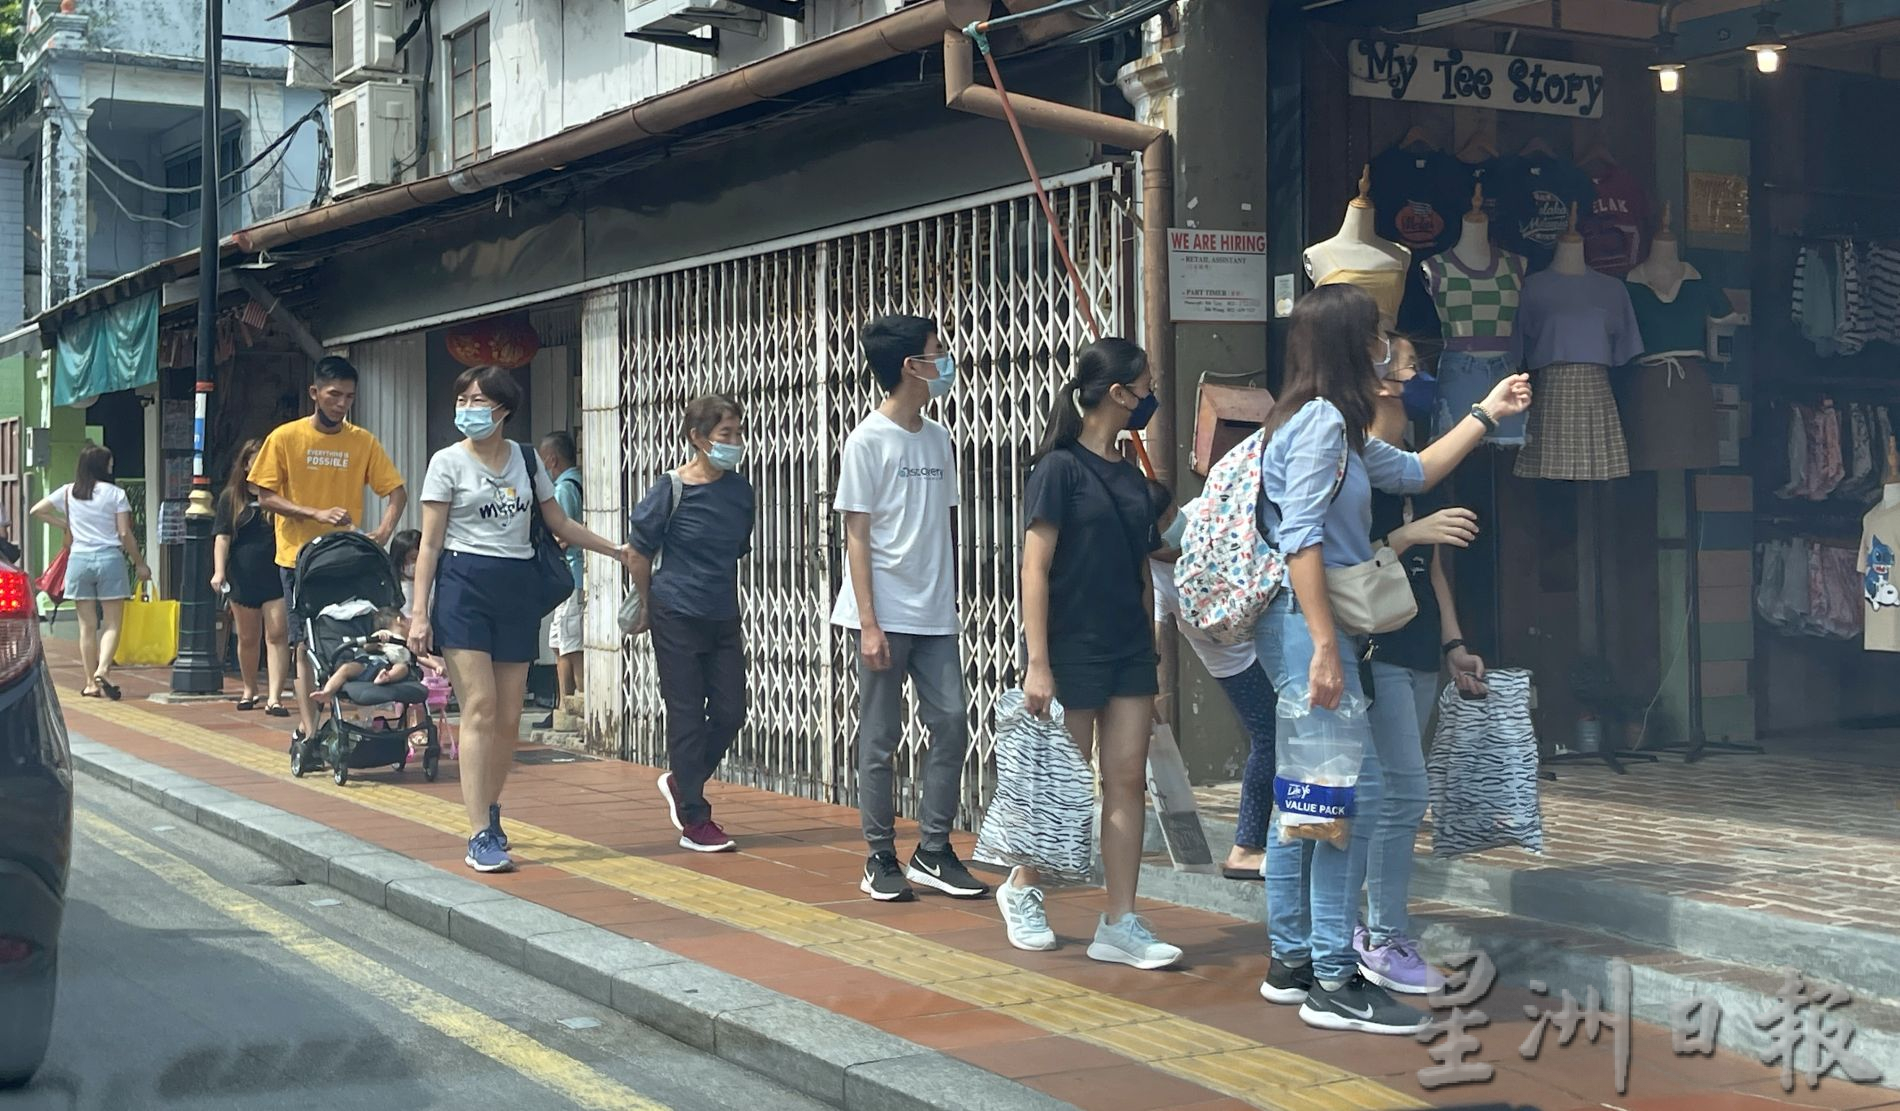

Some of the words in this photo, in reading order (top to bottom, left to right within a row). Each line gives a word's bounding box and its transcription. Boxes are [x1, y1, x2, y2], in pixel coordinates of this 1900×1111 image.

[1358, 39, 1418, 99] My
[1433, 50, 1493, 100] Tee
[1507, 58, 1604, 116] Story
[1171, 232, 1190, 250] WE
[1193, 233, 1217, 251] ARE
[1220, 234, 1266, 253] HIRING
[1185, 256, 1209, 264] RETAIL
[1212, 256, 1247, 265] ASSISTANT
[1206, 289, 1228, 297] TIMER
[306, 456, 350, 468] POSSIBLE
[1285, 799, 1317, 813] VALUE
[1319, 804, 1346, 816] PACK
